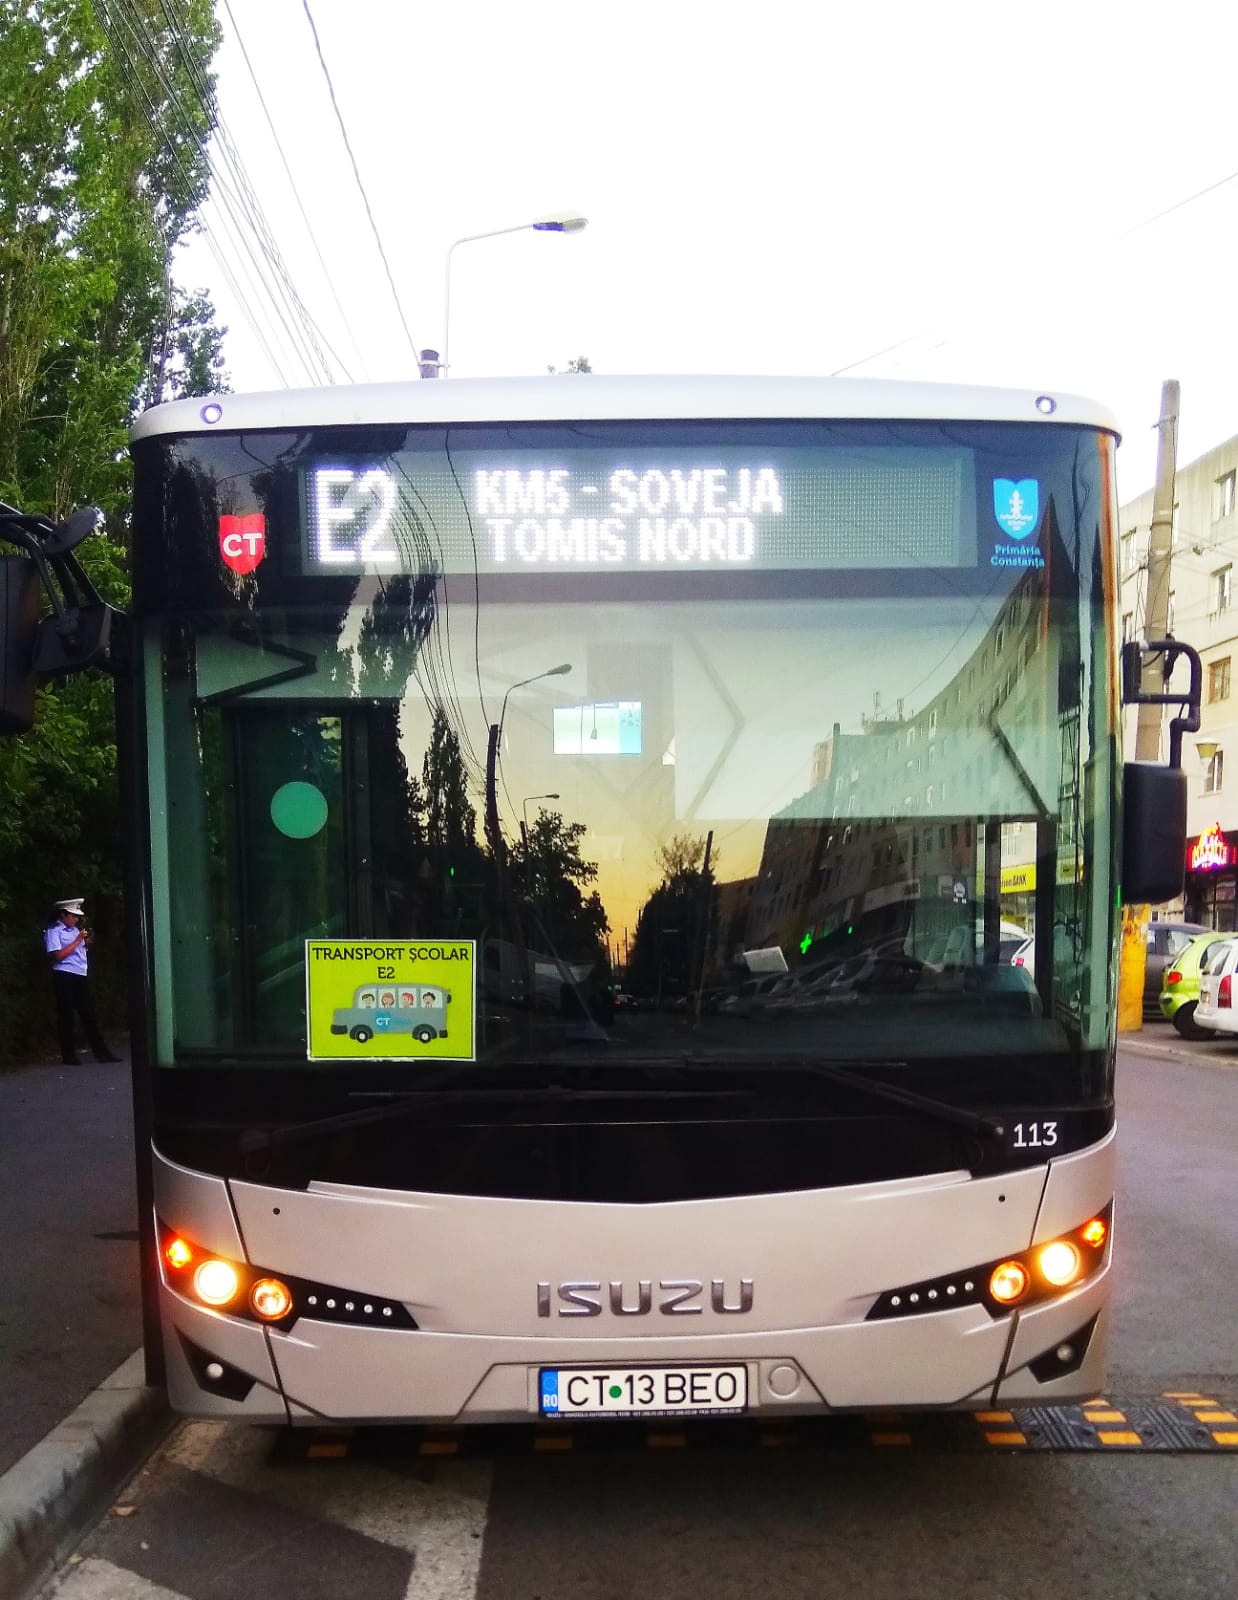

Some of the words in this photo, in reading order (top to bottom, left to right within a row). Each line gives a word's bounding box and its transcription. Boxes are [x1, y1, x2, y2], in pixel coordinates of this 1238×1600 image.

[475, 469, 570, 514] KM5
[609, 467, 783, 514] SOVEJA
[316, 469, 397, 563] E2
[223, 532, 262, 557] CT
[486, 517, 626, 562] TOMIS
[639, 517, 754, 561] NORD
[312, 948, 405, 960] TRANSPORT
[377, 966, 396, 979] E2
[376, 1017, 390, 1026] CT
[1013, 1121, 1058, 1148] 113
[537, 1279, 754, 1318] ISUZU
[543, 1393, 558, 1407] RO
[567, 1375, 610, 1407] CT
[624, 1374, 655, 1406] 13
[664, 1372, 737, 1405] BEO
